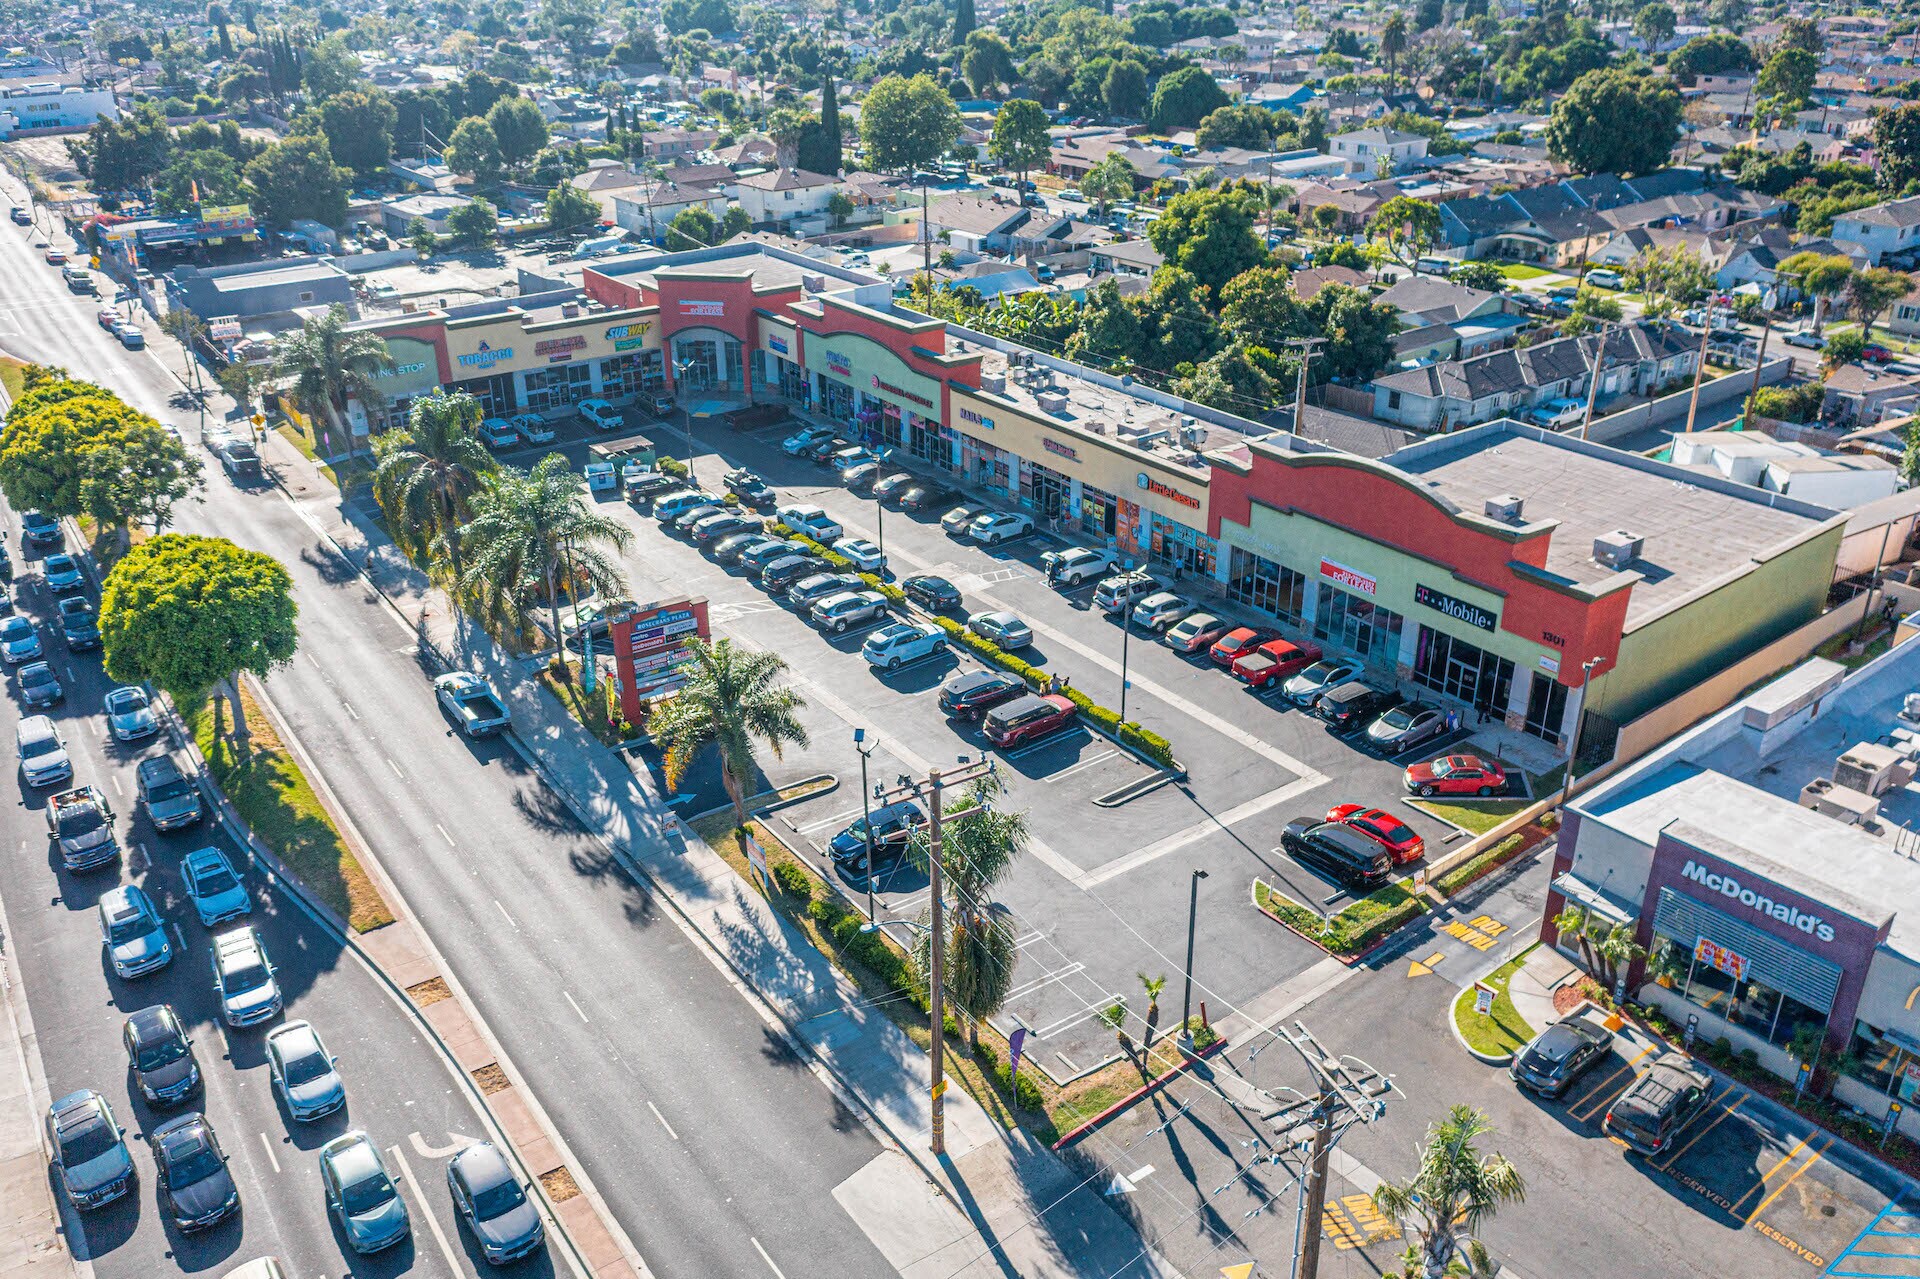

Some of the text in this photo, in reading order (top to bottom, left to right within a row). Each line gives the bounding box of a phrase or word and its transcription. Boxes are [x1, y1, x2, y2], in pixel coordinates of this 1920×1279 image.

[605, 322, 653, 340] SUBWAY
[457, 347, 513, 367] TOBACCO
[397, 362, 426, 375] STOP
[960, 408, 982, 425] NAILS
[1149, 479, 1200, 509] Little Caesars
[1333, 571, 1349, 585] FOR
[637, 616, 671, 631] ROSECRANS
[671, 612, 690, 621] PLAZA
[1542, 631, 1565, 647] 1301
[1681, 860, 1835, 942] McDonald's
[1440, 920, 1499, 952] THANK
[1468, 915, 1510, 937] YOU
[1666, 1167, 1731, 1209] RESERVED
[1754, 1221, 1824, 1267] RESERVED
